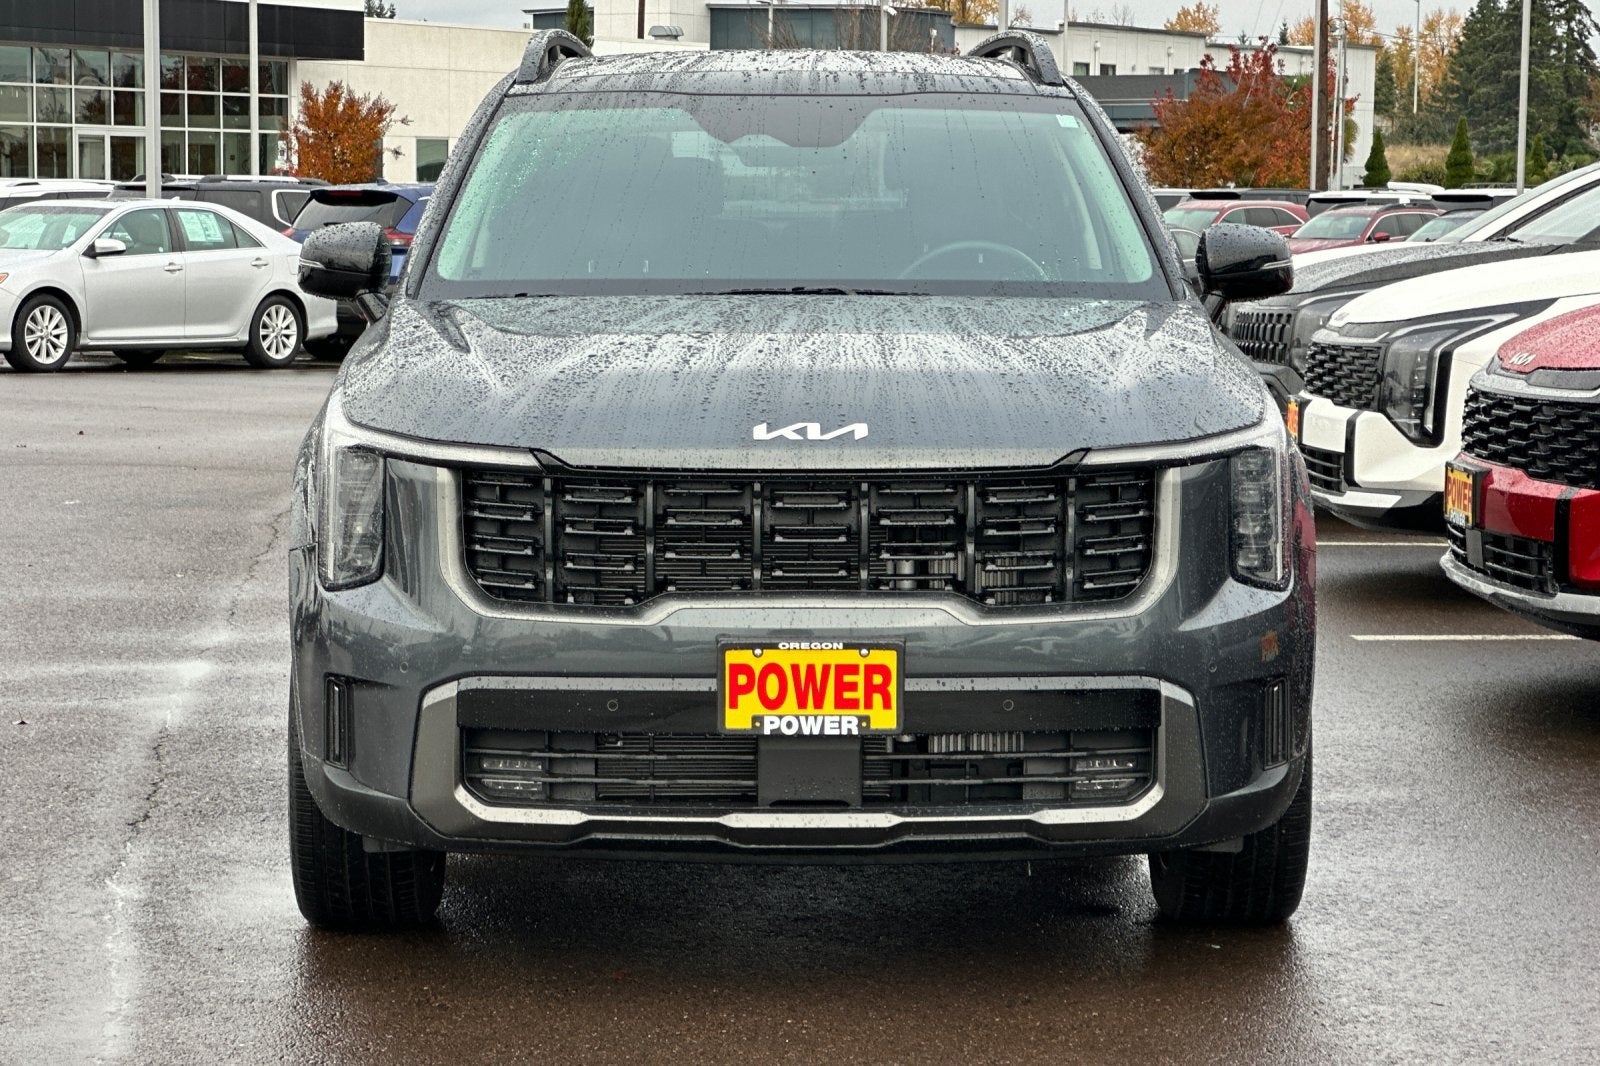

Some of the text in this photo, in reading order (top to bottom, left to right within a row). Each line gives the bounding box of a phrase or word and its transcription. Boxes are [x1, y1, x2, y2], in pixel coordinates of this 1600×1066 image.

[753, 422, 869, 440] KIA
[778, 642, 843, 650] OREGON
[728, 662, 892, 710] POWER
[763, 715, 859, 735] POWER
